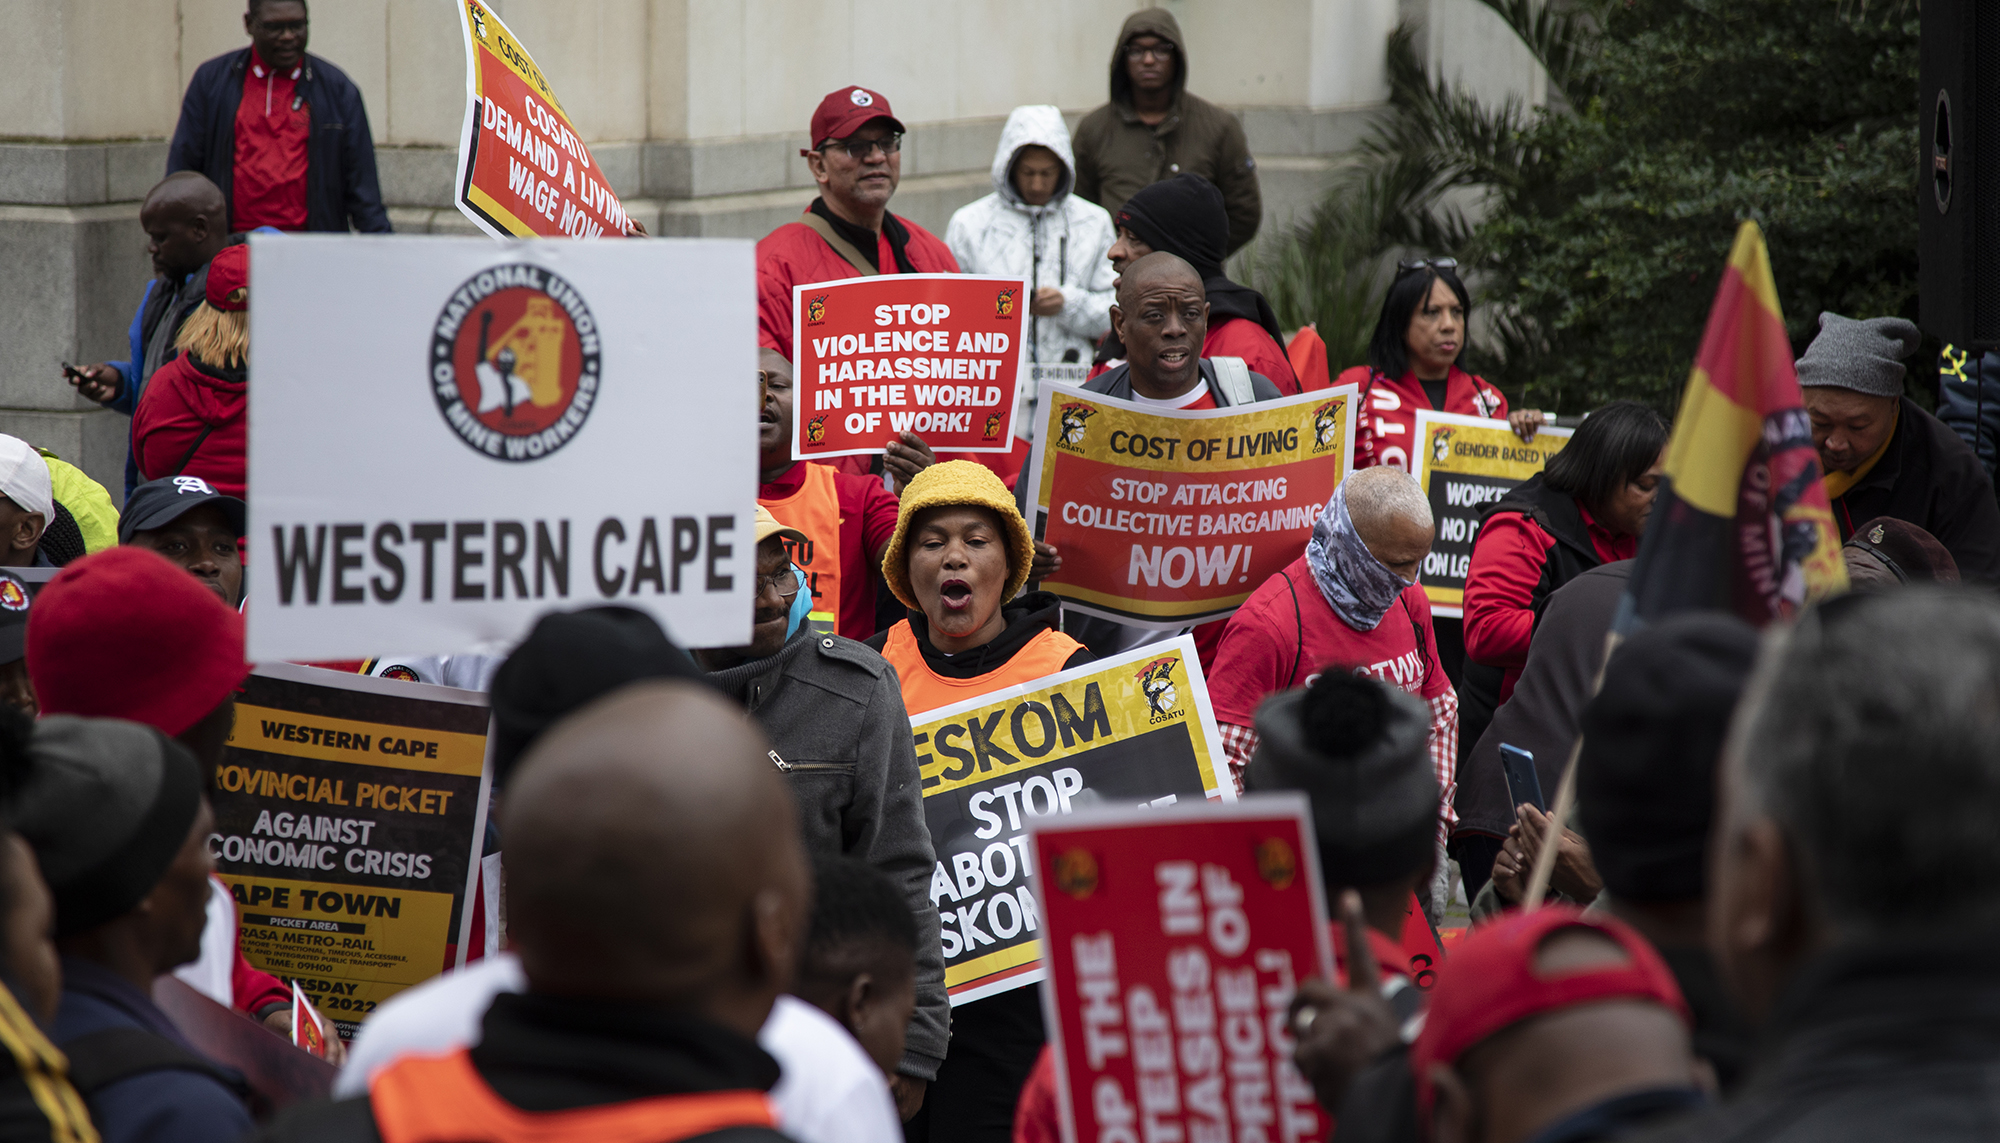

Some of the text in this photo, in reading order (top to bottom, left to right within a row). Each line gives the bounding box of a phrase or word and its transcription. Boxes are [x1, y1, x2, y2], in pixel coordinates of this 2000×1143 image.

[498, 36, 532, 79] COST
[483, 96, 559, 178] DEMAND
[563, 160, 576, 195] A
[525, 95, 590, 169] COSATU
[508, 155, 560, 222] WAGE
[437, 266, 599, 356] NATIONAL UNION
[874, 303, 951, 327] STOP
[812, 330, 1010, 359] VIOLENCE AND
[818, 357, 1003, 385] HARASSMENT
[433, 361, 598, 460] OF MINE WORKERS
[814, 384, 1002, 411] IN THE WORLD
[844, 412, 973, 435] OF WORK!
[1055, 441, 1085, 455] COSATU
[1110, 427, 1299, 462] COST OF LIVING
[1312, 443, 1338, 455] COSATU
[1454, 441, 1499, 460] GENDER
[1502, 447, 1539, 464] BASED
[1110, 476, 1288, 506] STOP ATTACKING
[1062, 501, 1323, 537] COLLECTIVE BARGAINING
[1440, 516, 1467, 543] NO
[272, 515, 736, 607] WESTERN CAPE
[1127, 544, 1253, 589] NOW!
[1424, 551, 1449, 577] ON
[1148, 709, 1186, 726] COSATU
[261, 720, 439, 760] WESTERN CAPE
[914, 681, 1114, 790] ESKOM
[355, 782, 454, 816] PICKET
[968, 767, 1084, 840] STOP
[252, 810, 376, 846] AGAINST
[344, 849, 433, 880] CRISIS
[299, 889, 402, 919] TOWN
[1154, 860, 1204, 938] IN
[1201, 862, 1251, 959] OF
[269, 917, 339, 932] PICKET AREA
[247, 940, 270, 948] MORE
[254, 948, 272, 956] AND
[274, 950, 320, 961] INTEGRATED
[321, 956, 348, 964] PUBLIC
[281, 932, 376, 951] METRO-RAIL
[265, 957, 333, 973] TIME: 09H00
[327, 996, 378, 1013] 2022
[1071, 930, 1129, 1073] THE
